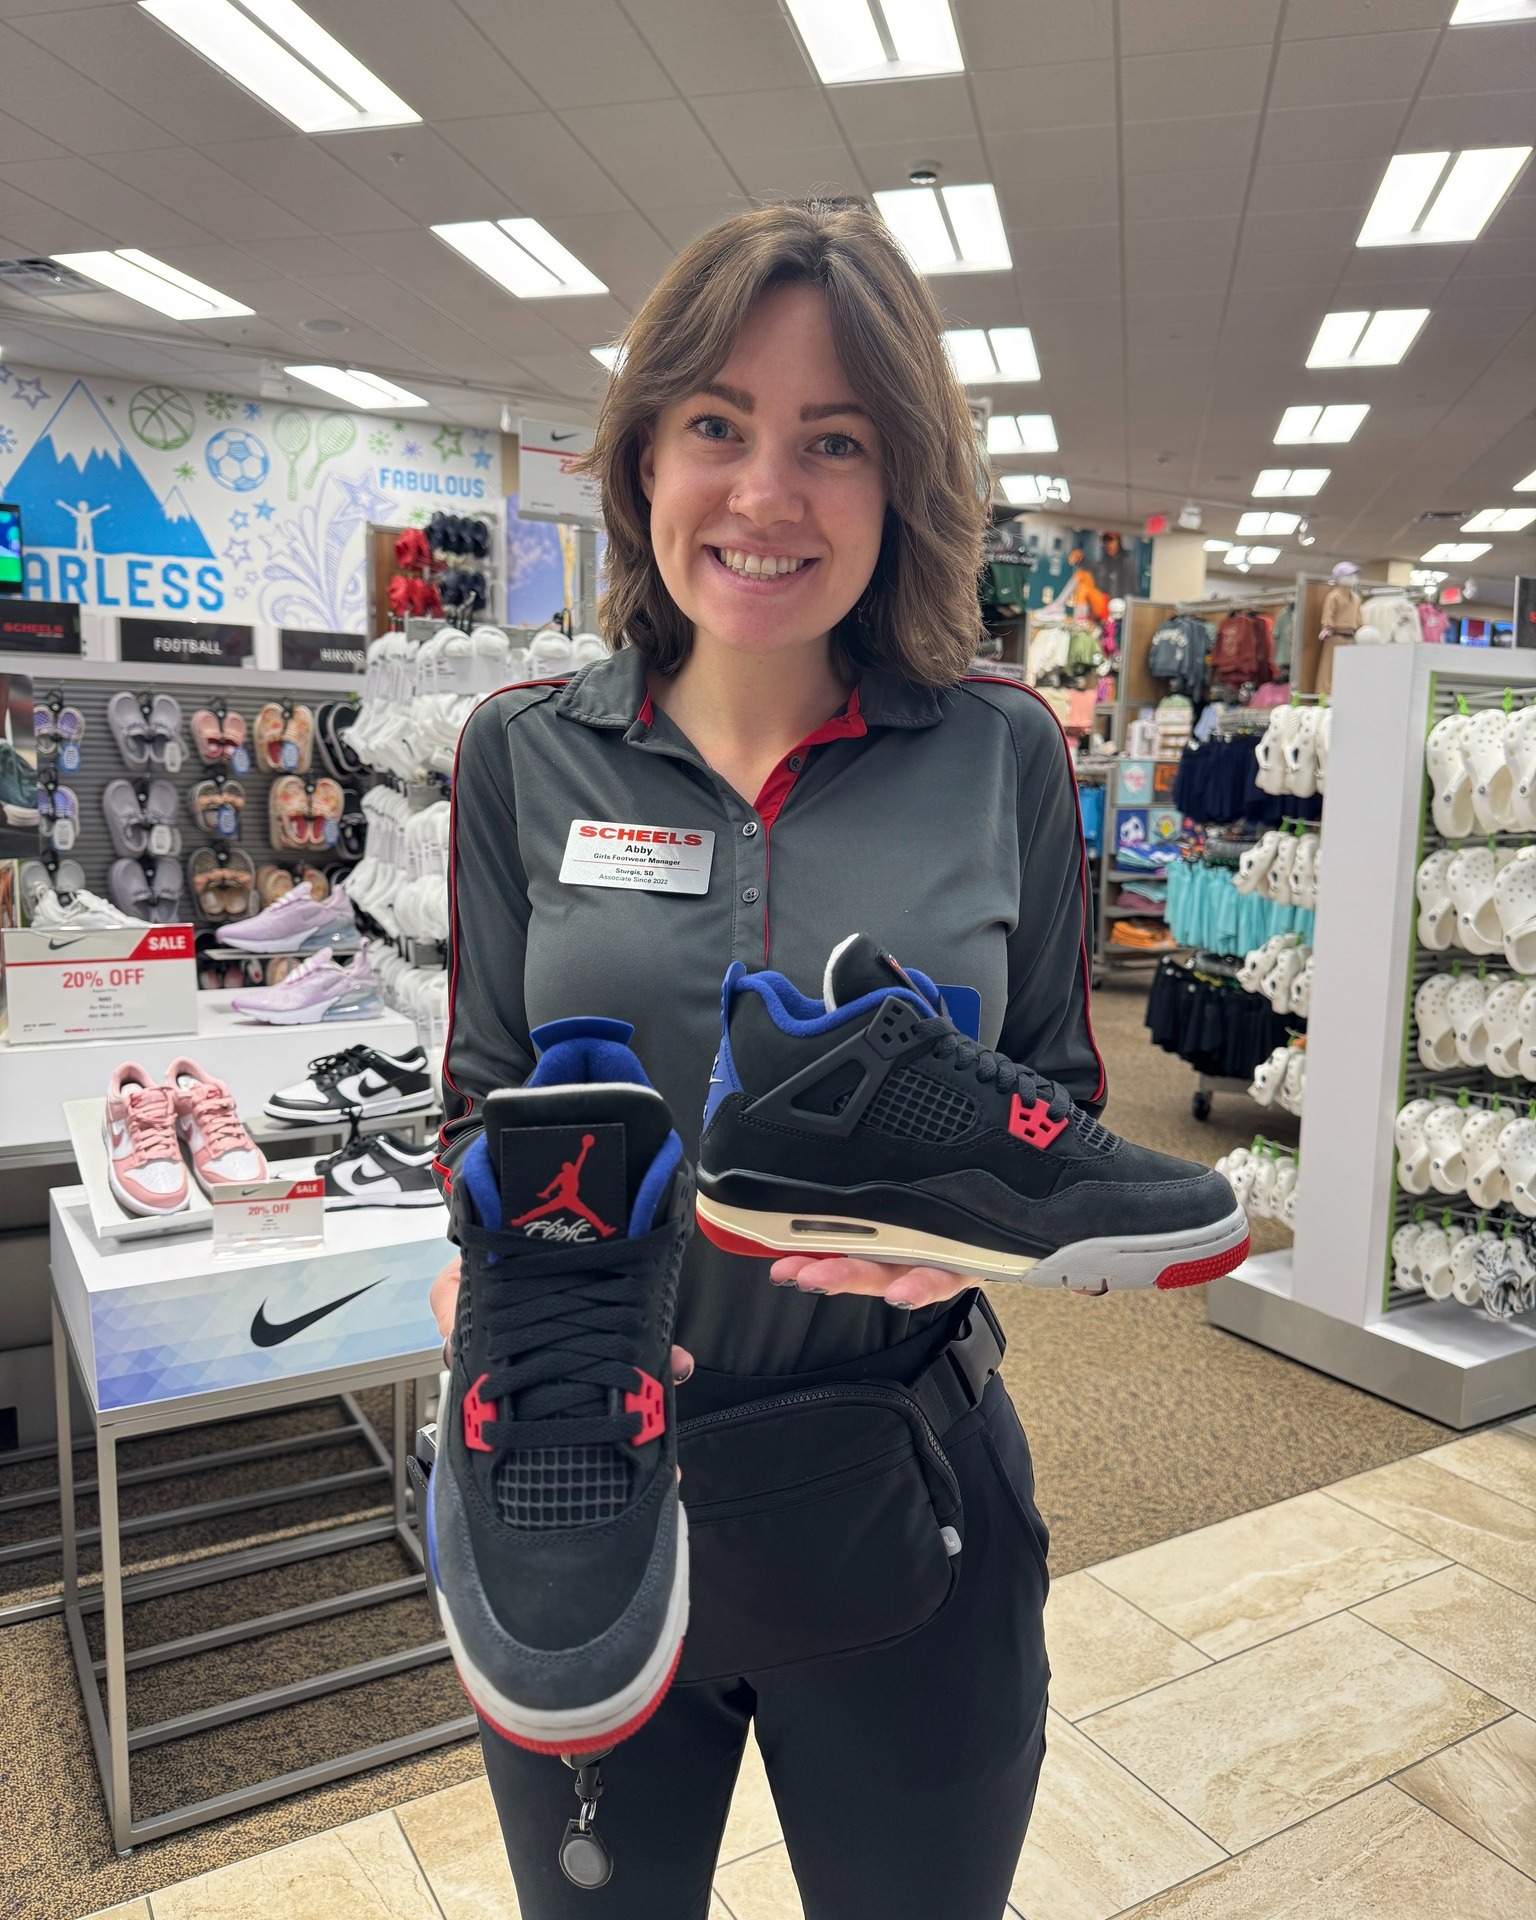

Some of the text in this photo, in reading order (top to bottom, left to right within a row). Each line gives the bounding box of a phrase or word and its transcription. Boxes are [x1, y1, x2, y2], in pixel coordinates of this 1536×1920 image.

[379, 468, 485, 498] FABULOUS
[22, 553, 224, 612] ARLESS
[153, 637, 223, 655] FOOTBALL
[578, 825, 703, 846] SCHEELS
[624, 845, 653, 856] Abby
[612, 854, 646, 863] Footwear
[648, 857, 681, 866] Manager
[599, 873, 632, 882] Associate
[633, 876, 652, 884] Since
[147, 936, 187, 951] SALE
[62, 968, 145, 988] 20% OFF
[295, 1184, 318, 1194] SALE
[248, 1203, 291, 1216] 20% OFF
